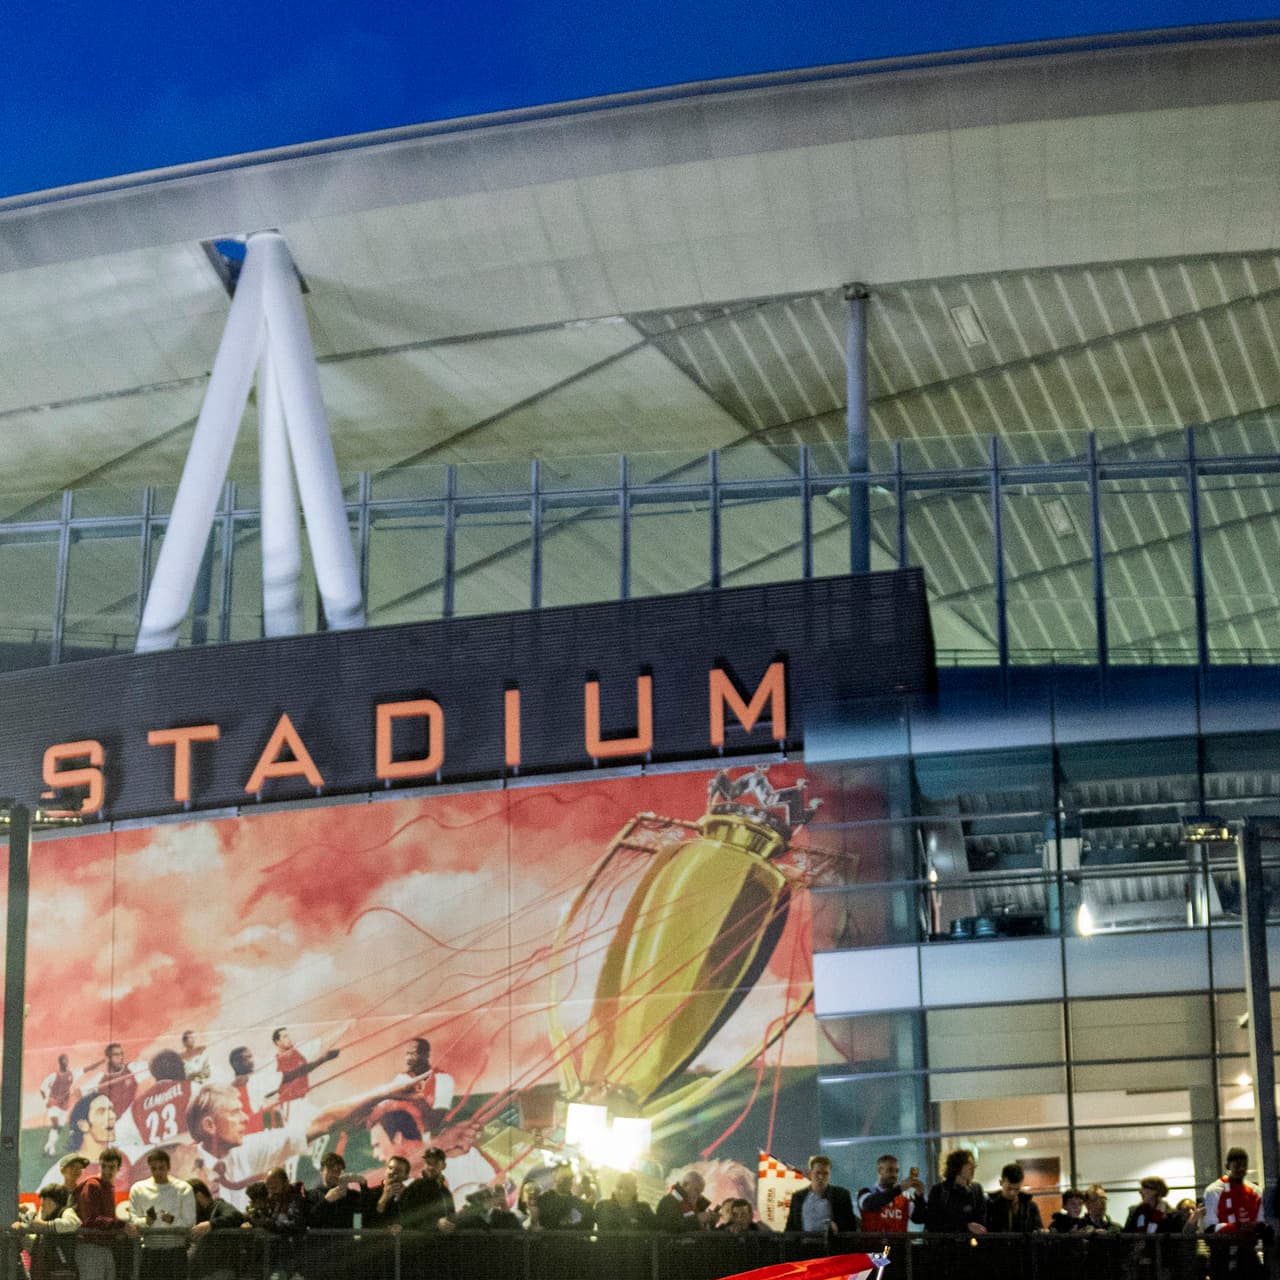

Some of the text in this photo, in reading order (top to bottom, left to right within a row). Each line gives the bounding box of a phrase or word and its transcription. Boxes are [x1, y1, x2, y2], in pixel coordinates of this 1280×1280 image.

[41, 660, 788, 817] STADIUM
[146, 1103, 178, 1144] 23
[880, 1207, 903, 1220] JVC
